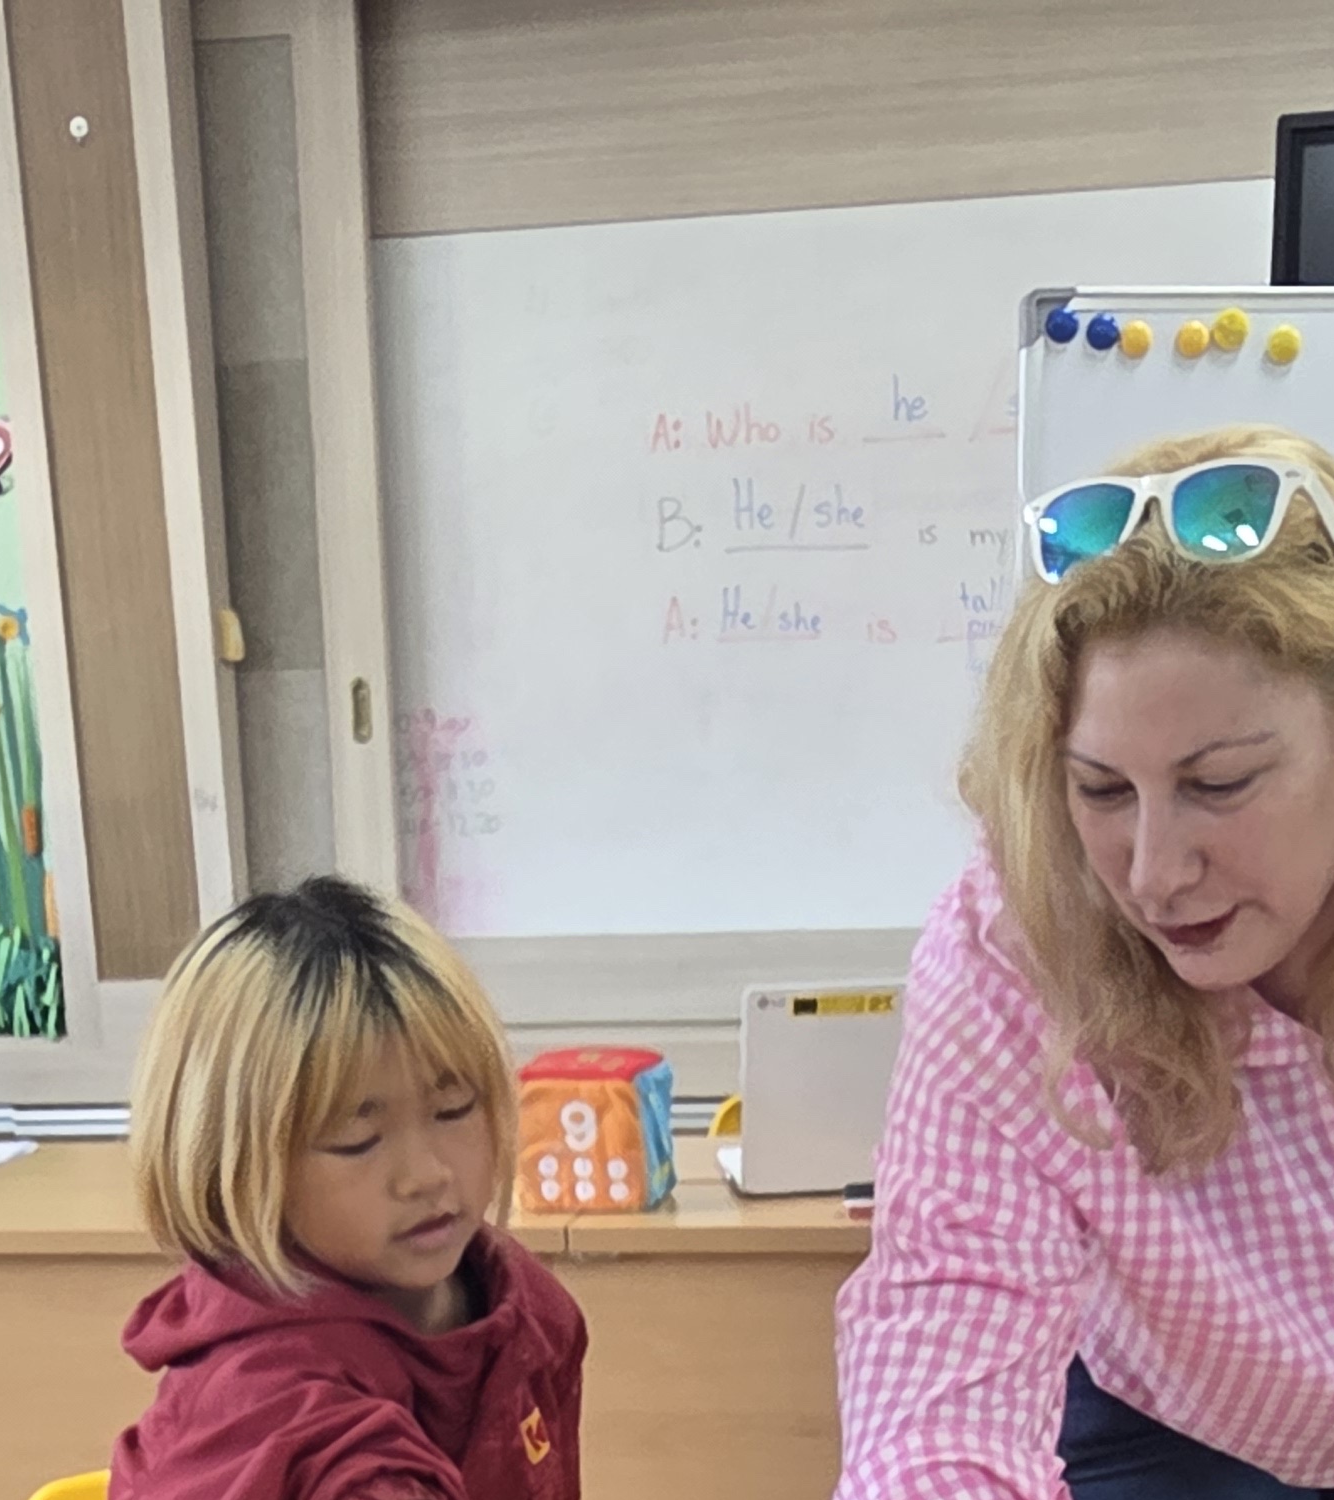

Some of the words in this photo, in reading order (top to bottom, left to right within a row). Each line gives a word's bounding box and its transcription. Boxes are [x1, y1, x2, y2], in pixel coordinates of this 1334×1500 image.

[651, 413, 683, 451] A:
[706, 402, 781, 449] Who
[809, 413, 835, 445] is
[656, 496, 703, 552] B:
[918, 524, 939, 545] is
[969, 527, 1010, 566] my
[959, 575, 1005, 614] tall
[662, 595, 698, 645] A:
[867, 618, 897, 645] is
